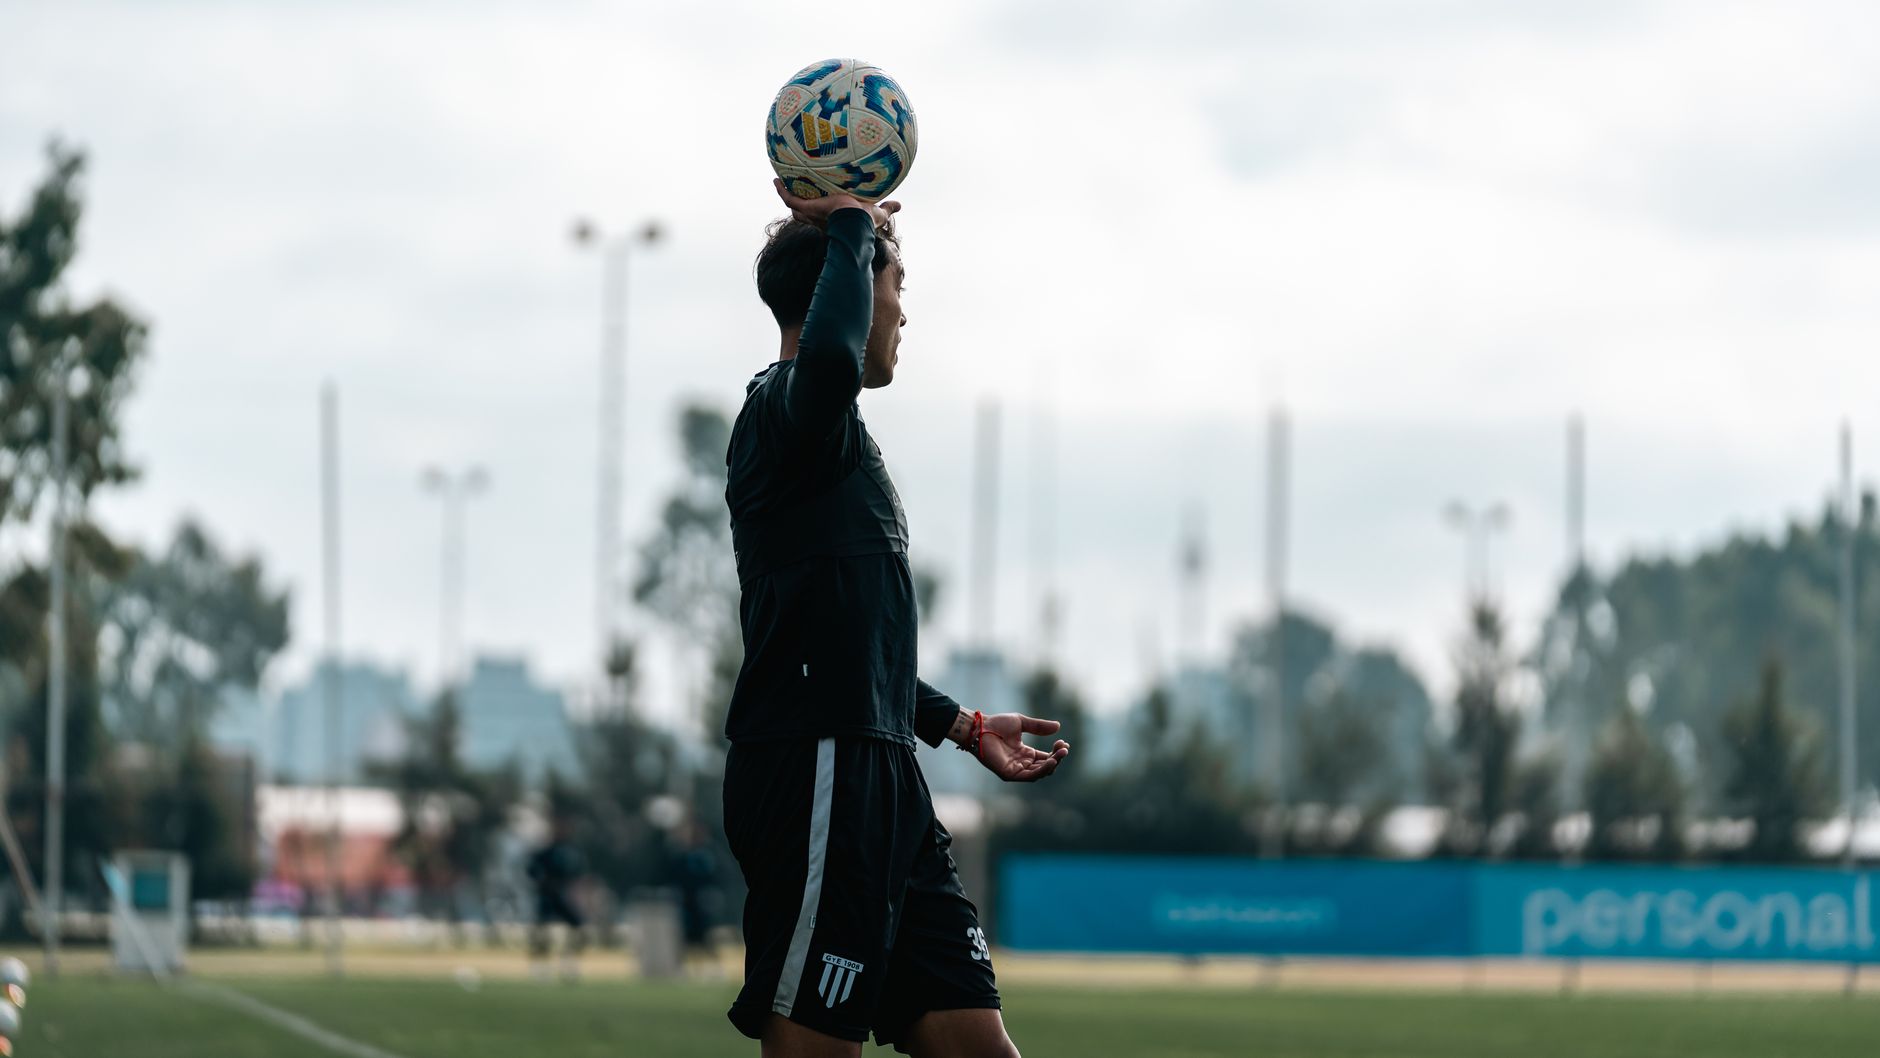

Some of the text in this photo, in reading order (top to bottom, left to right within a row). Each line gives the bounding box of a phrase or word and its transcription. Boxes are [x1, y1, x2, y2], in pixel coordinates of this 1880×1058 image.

[1521, 872, 1875, 959] personal
[967, 927, 990, 961] 36
[844, 960, 861, 970] 1908
